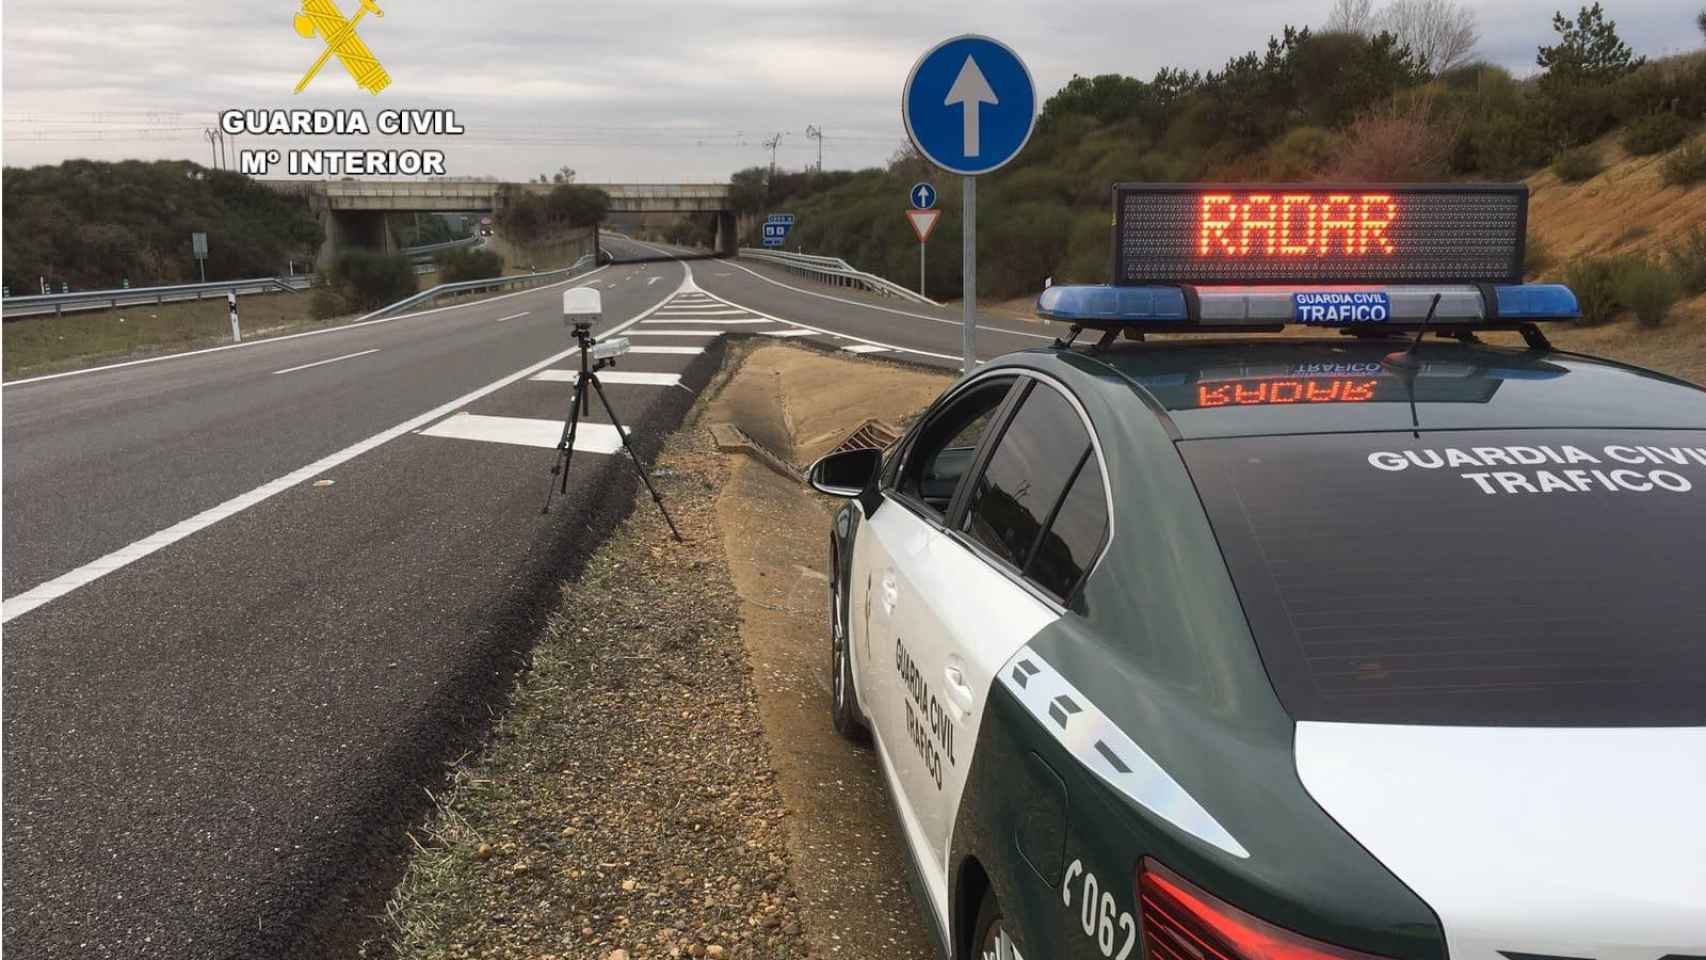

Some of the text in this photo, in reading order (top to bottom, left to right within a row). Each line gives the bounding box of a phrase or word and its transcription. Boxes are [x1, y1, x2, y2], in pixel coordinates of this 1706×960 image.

[1200, 194, 1397, 256] RADAR
[1296, 294, 1387, 304] GUARDIA CIVIL
[1298, 305, 1387, 321] TRAFICO
[1367, 445, 1602, 471] GUARDIA
[1461, 469, 1692, 494] TRAFICO
[896, 637, 955, 768] GUARDIA CIVIL
[905, 697, 942, 791] TRAFICO
[1081, 872, 1136, 960] 062
